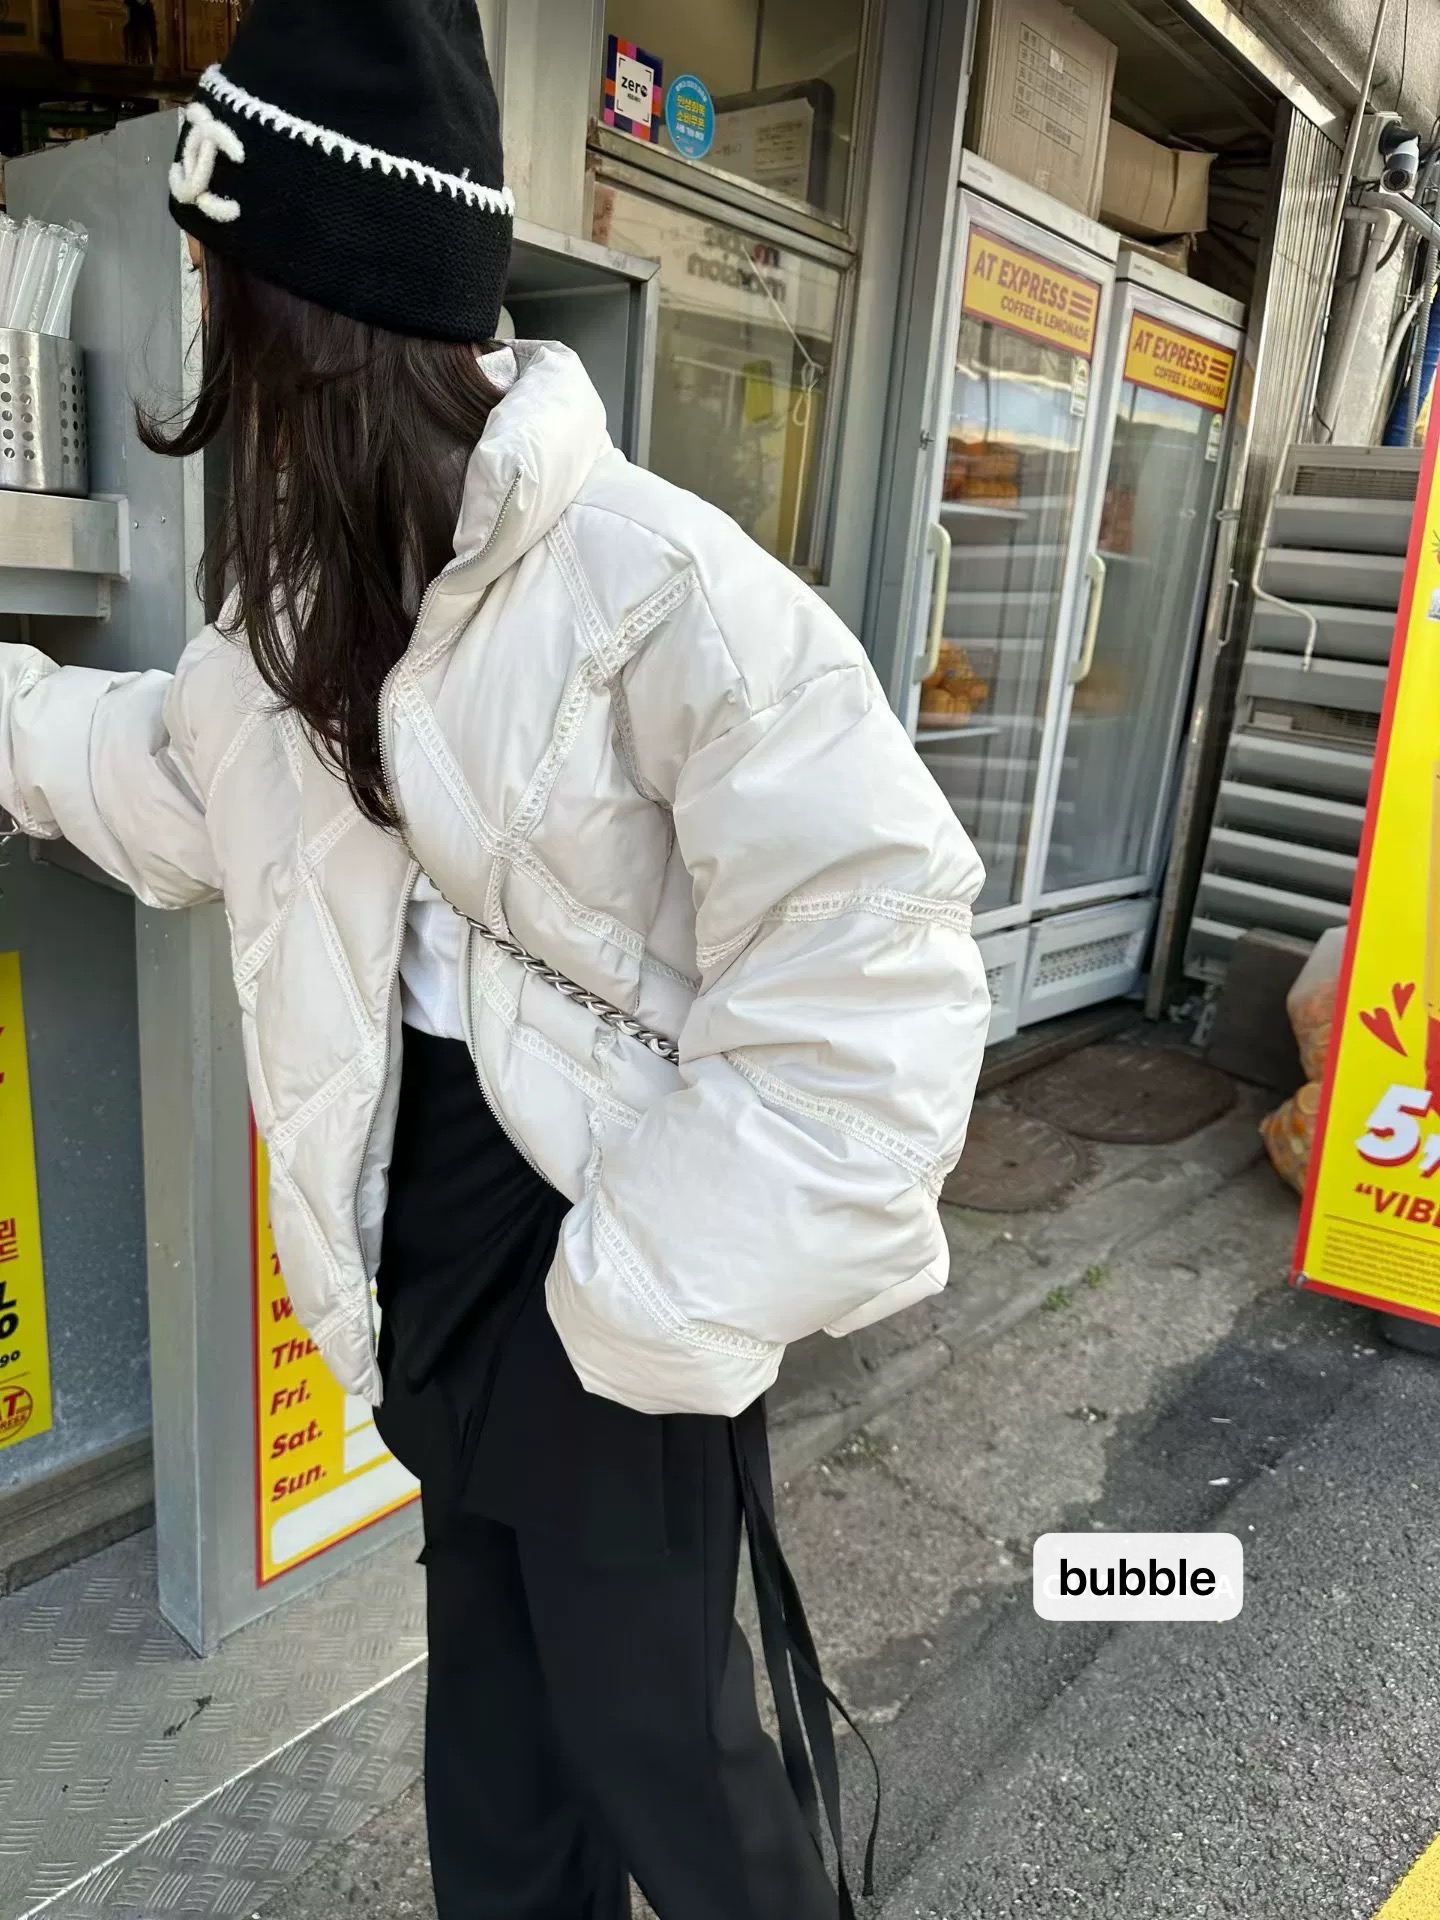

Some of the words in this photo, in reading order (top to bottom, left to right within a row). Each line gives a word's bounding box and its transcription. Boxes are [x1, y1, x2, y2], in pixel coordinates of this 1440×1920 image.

[973, 250, 998, 281] AT
[998, 259, 1068, 311] EXPRESS
[1001, 295, 1036, 320] COFFEE
[1043, 311, 1090, 342] LEMONADE
[1134, 330, 1153, 354] AT
[1152, 336, 1210, 375] EXPRESS
[1154, 365, 1180, 384] COFFEE
[270, 1379, 311, 1415] Fri.
[271, 1418, 323, 1459] Sat.
[271, 1464, 327, 1502] Sun.
